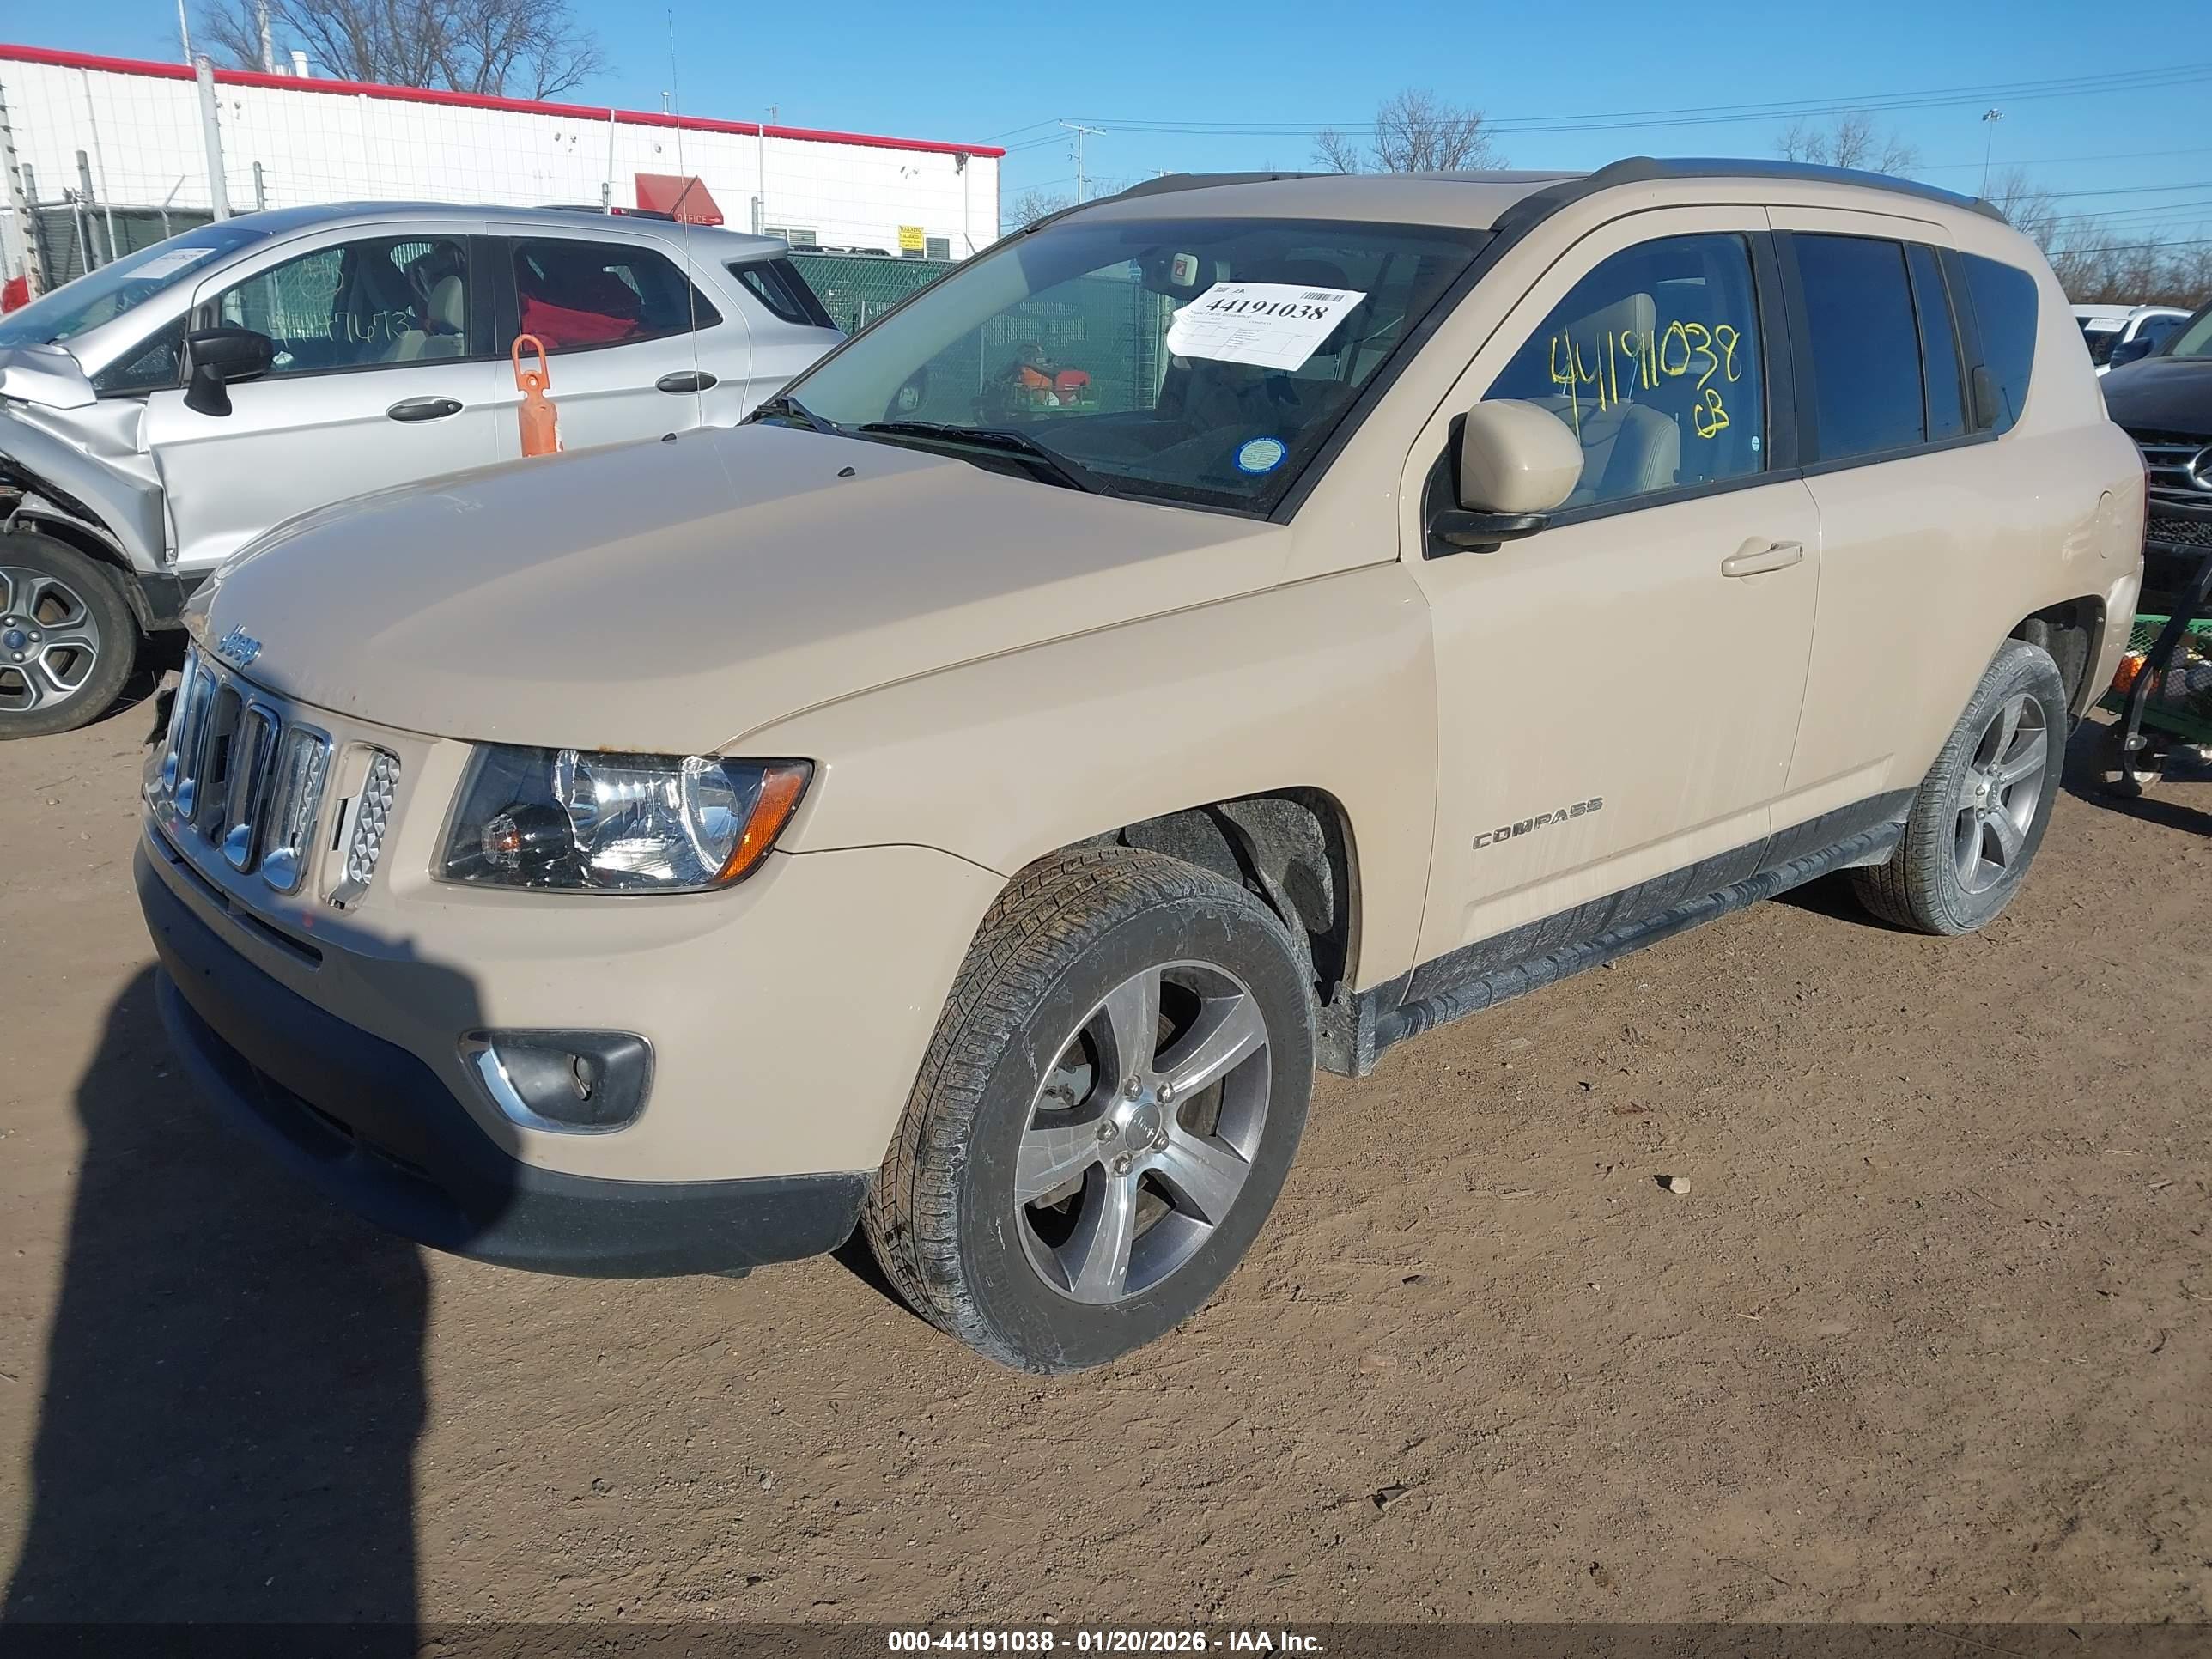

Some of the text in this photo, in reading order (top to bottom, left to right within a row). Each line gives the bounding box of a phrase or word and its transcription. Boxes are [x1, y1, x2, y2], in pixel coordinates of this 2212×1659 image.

[1206, 298, 1329, 321] 44191038
[1551, 320, 1742, 444] 44191038
[1472, 796, 1604, 850] COMPASS
